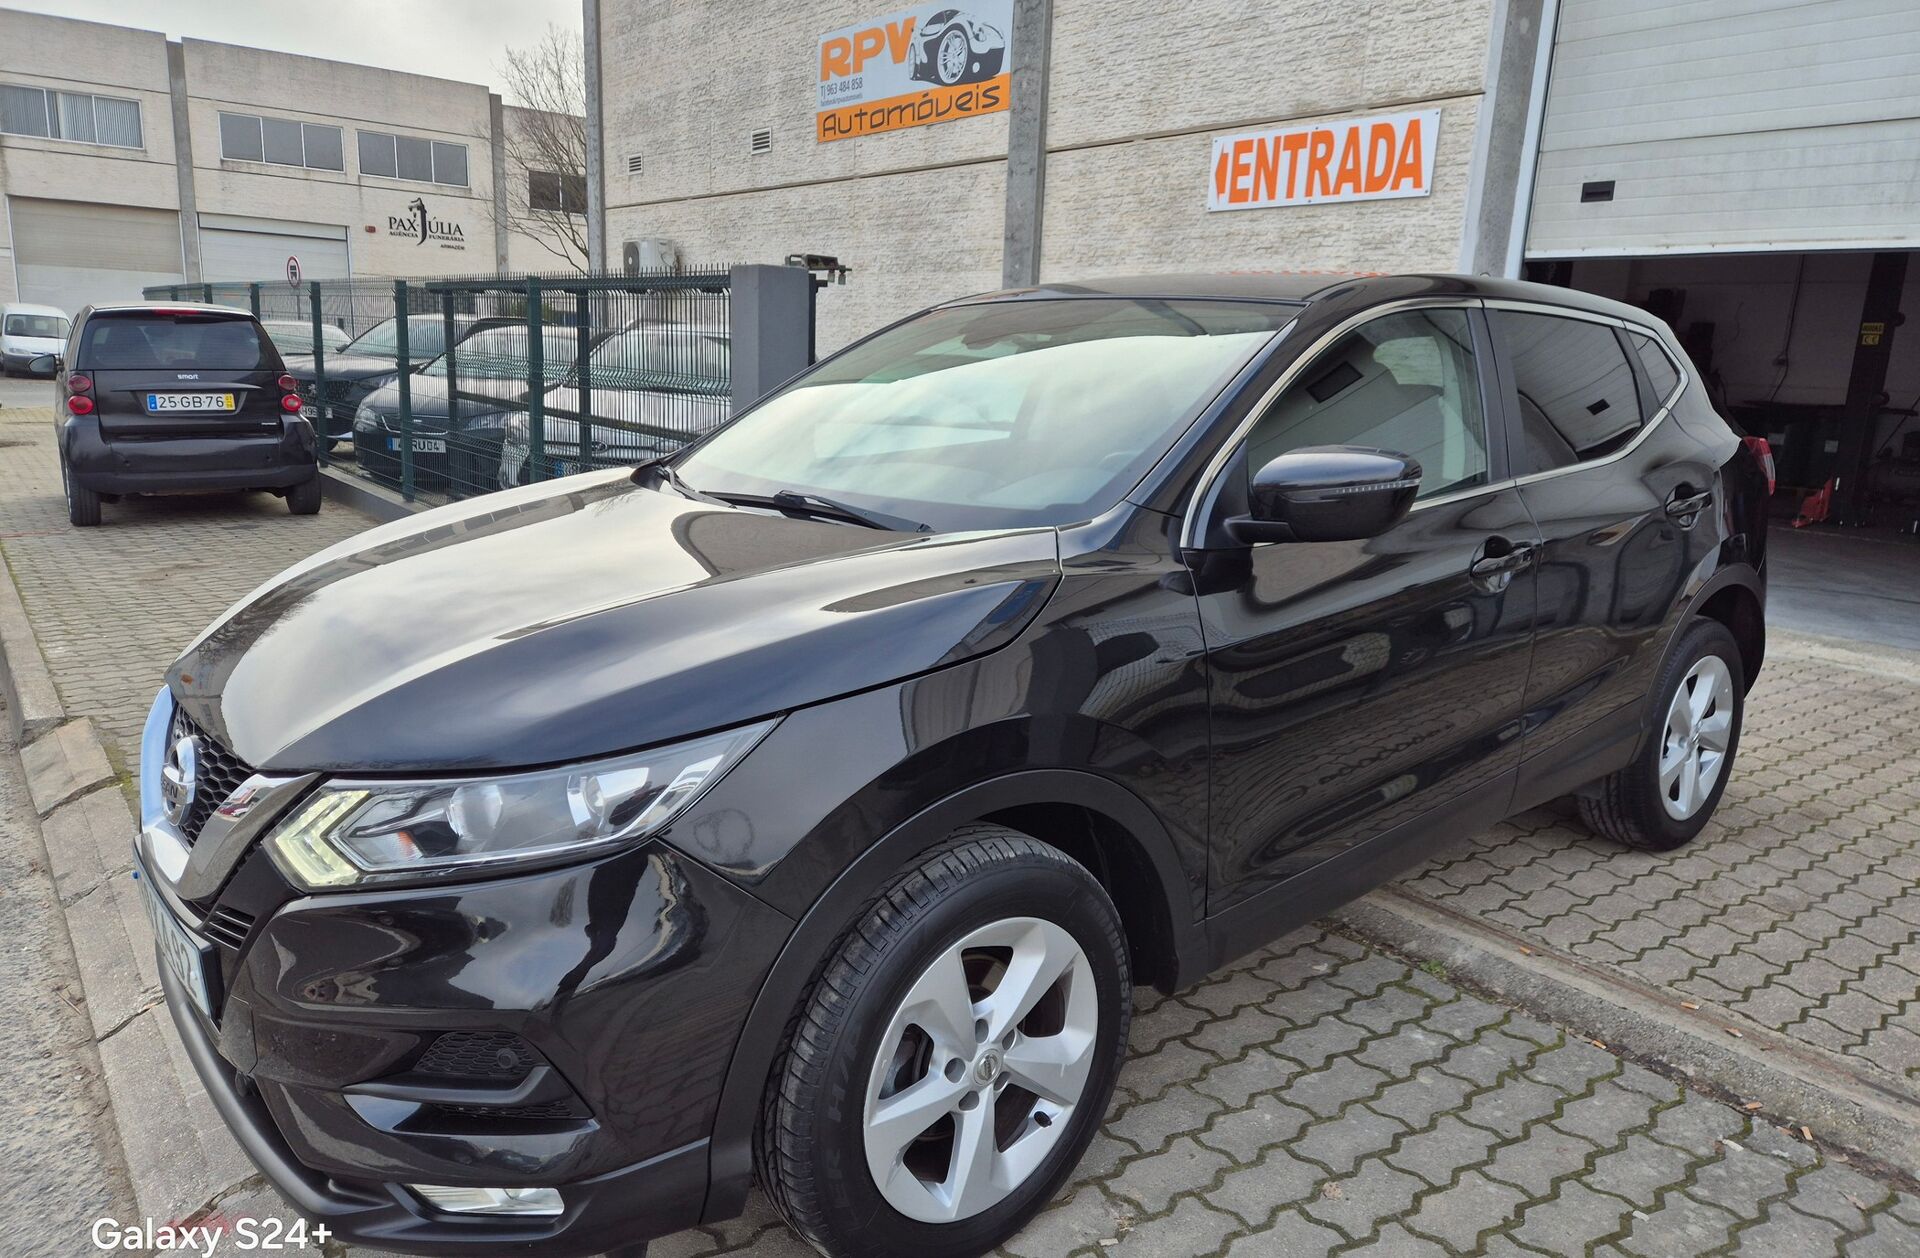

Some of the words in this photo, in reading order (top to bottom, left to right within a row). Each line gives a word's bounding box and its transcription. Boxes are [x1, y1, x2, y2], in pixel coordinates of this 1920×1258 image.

[820, 16, 917, 82] RPV
[822, 84, 1001, 138] Automóveis
[826, 83, 837, 96] 963
[839, 80, 850, 93] 484
[851, 77, 863, 90] 858
[1228, 118, 1423, 204] ENTRADA
